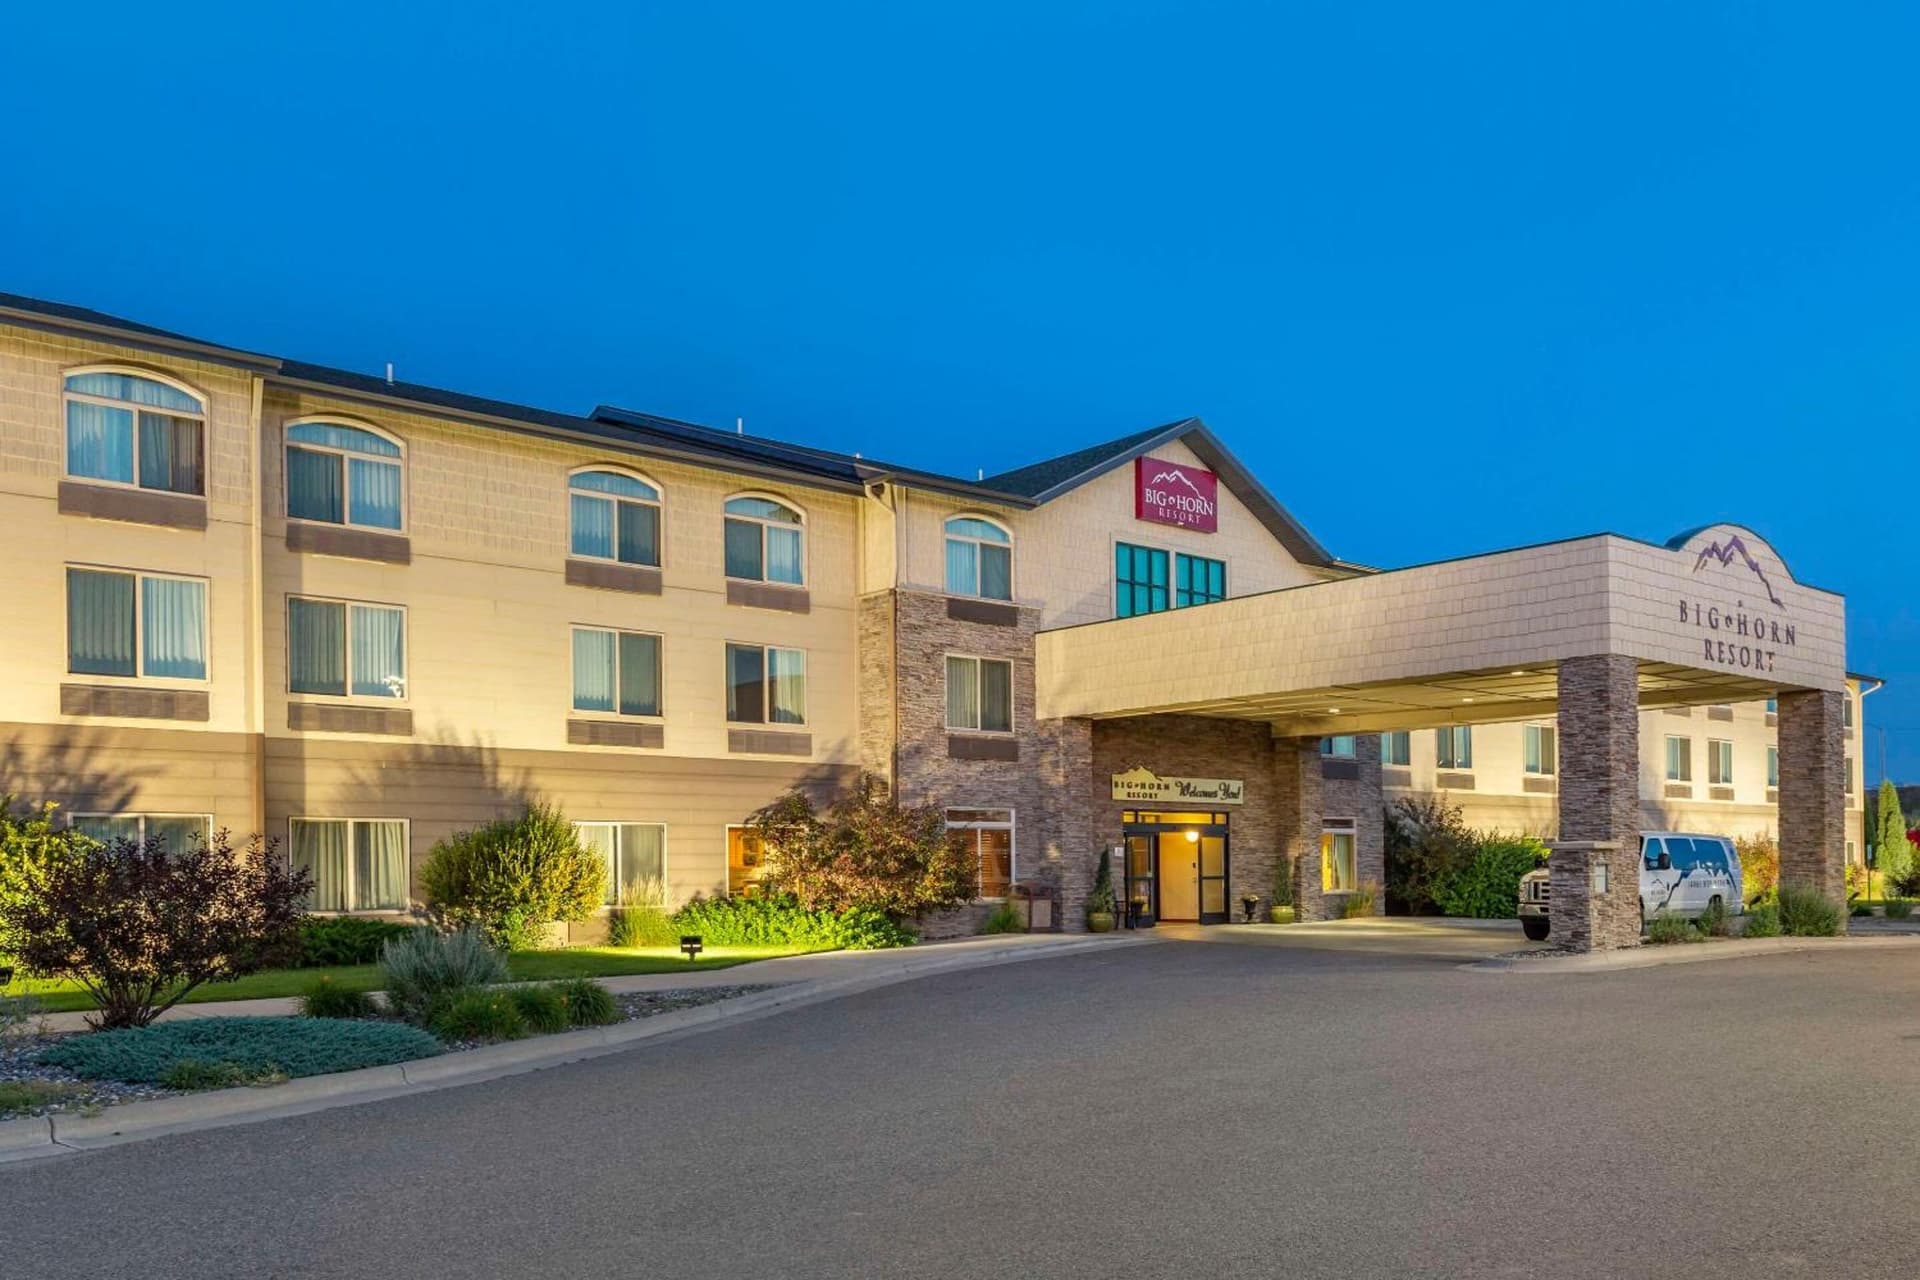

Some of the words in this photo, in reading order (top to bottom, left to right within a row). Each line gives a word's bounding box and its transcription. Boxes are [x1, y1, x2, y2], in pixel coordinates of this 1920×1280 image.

[1145, 488, 1167, 506] BIG
[1177, 495, 1213, 516] HORN
[1159, 507, 1200, 524] RESORT
[1680, 599, 1719, 629] BIG
[1737, 613, 1796, 646] HORN
[1704, 638, 1775, 672] RESORT
[1114, 781, 1133, 789] BIG
[1140, 782, 1170, 790] HORN
[1174, 780, 1218, 798] Welcomes
[1127, 791, 1158, 799] RESORT
